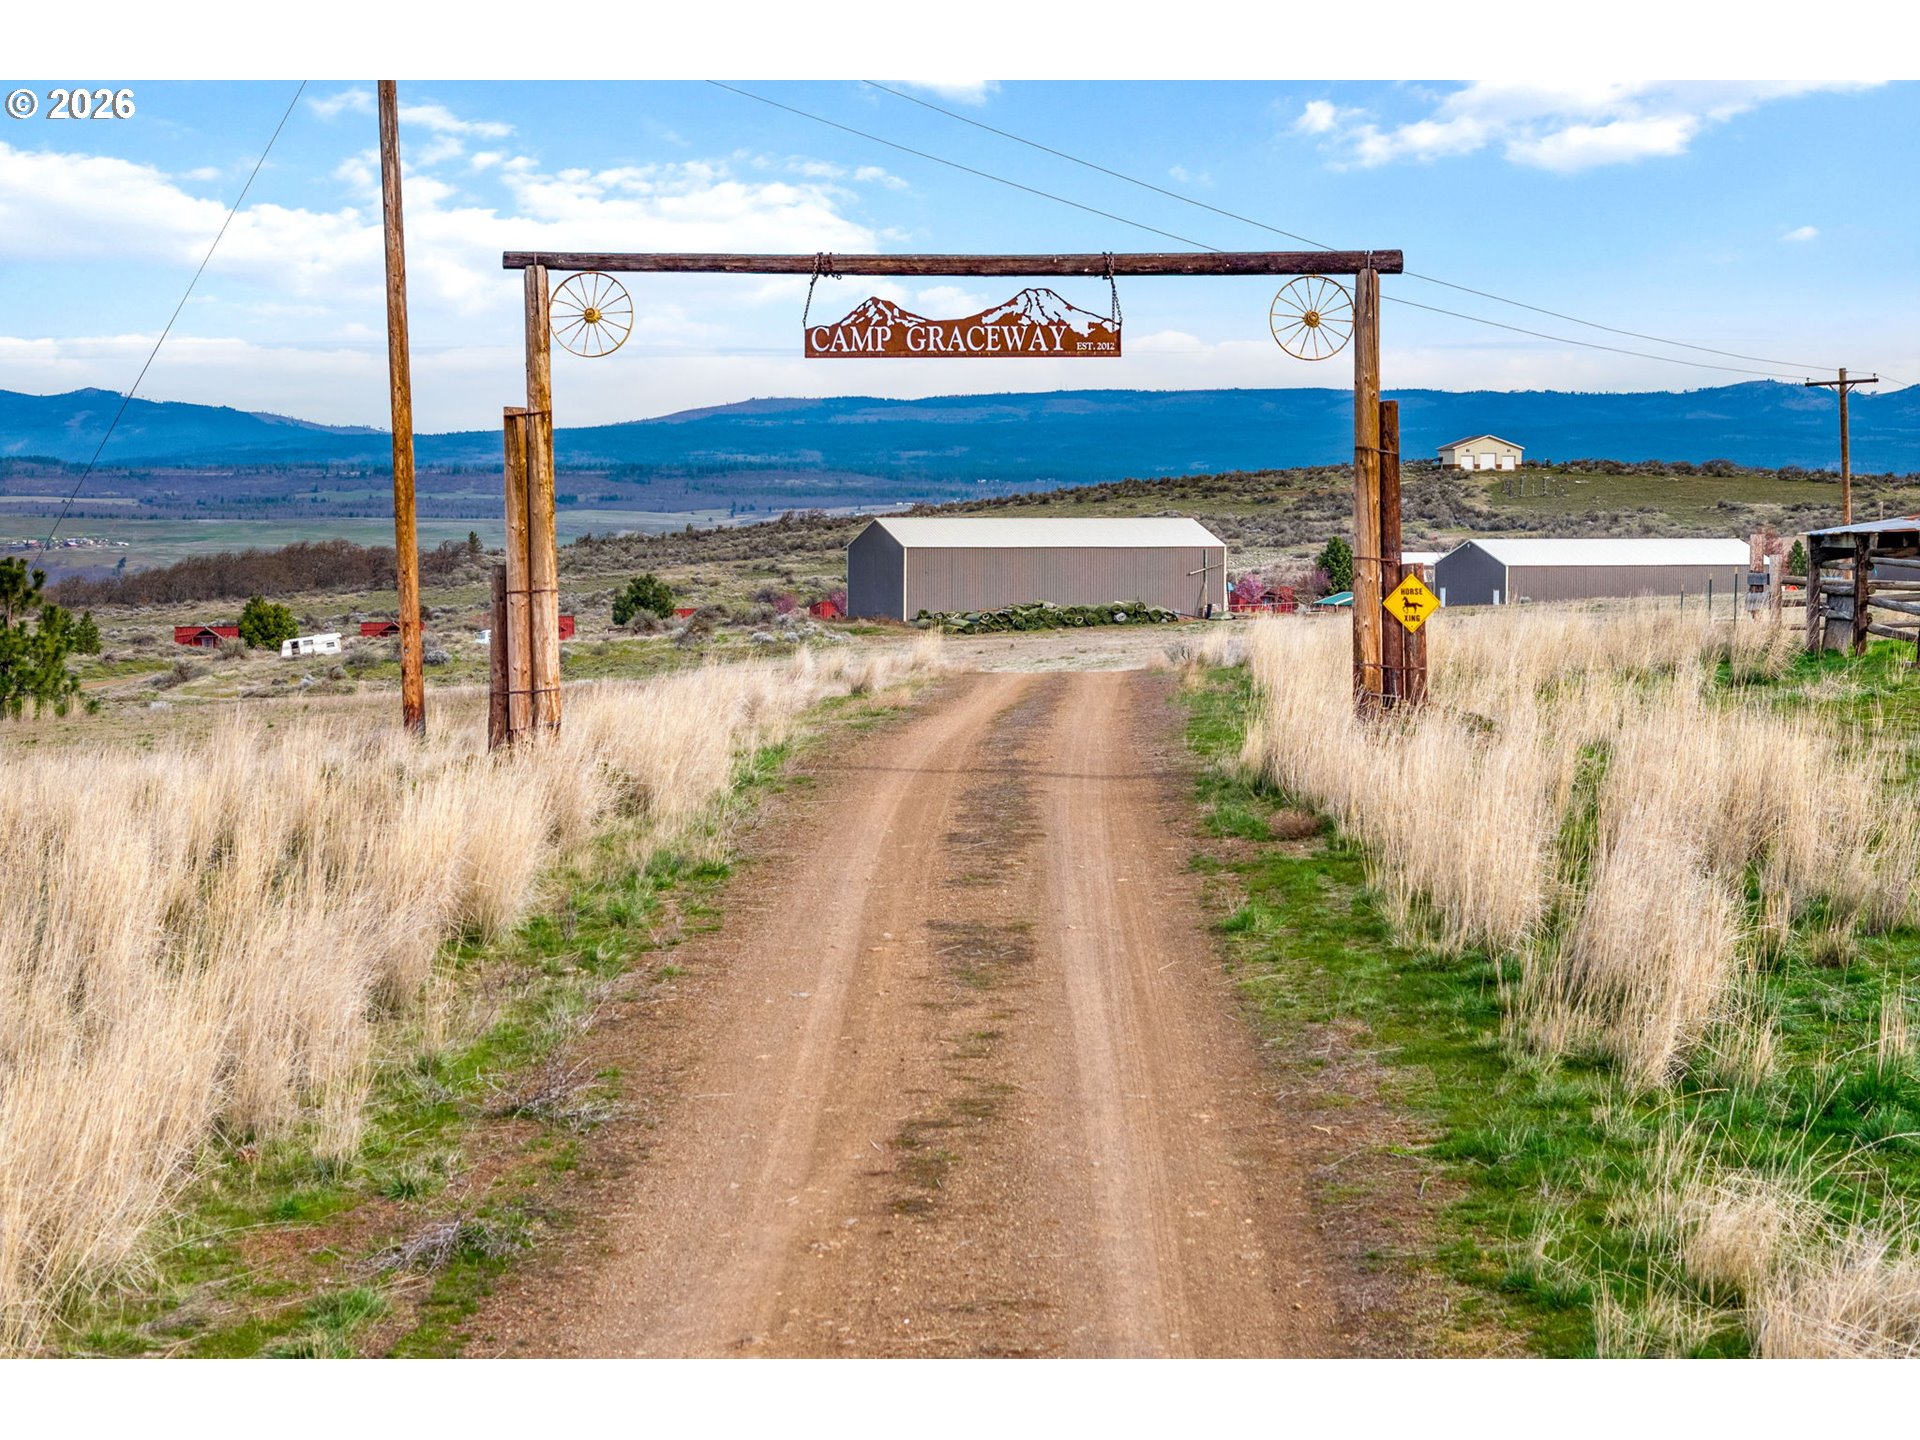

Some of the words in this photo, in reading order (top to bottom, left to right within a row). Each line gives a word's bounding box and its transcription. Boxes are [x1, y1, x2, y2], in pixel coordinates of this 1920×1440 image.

[811, 325, 891, 352] CAMP
[906, 325, 1067, 352] GRACEWAY
[1076, 341, 1095, 351] EST.
[1096, 341, 1115, 351] 2012
